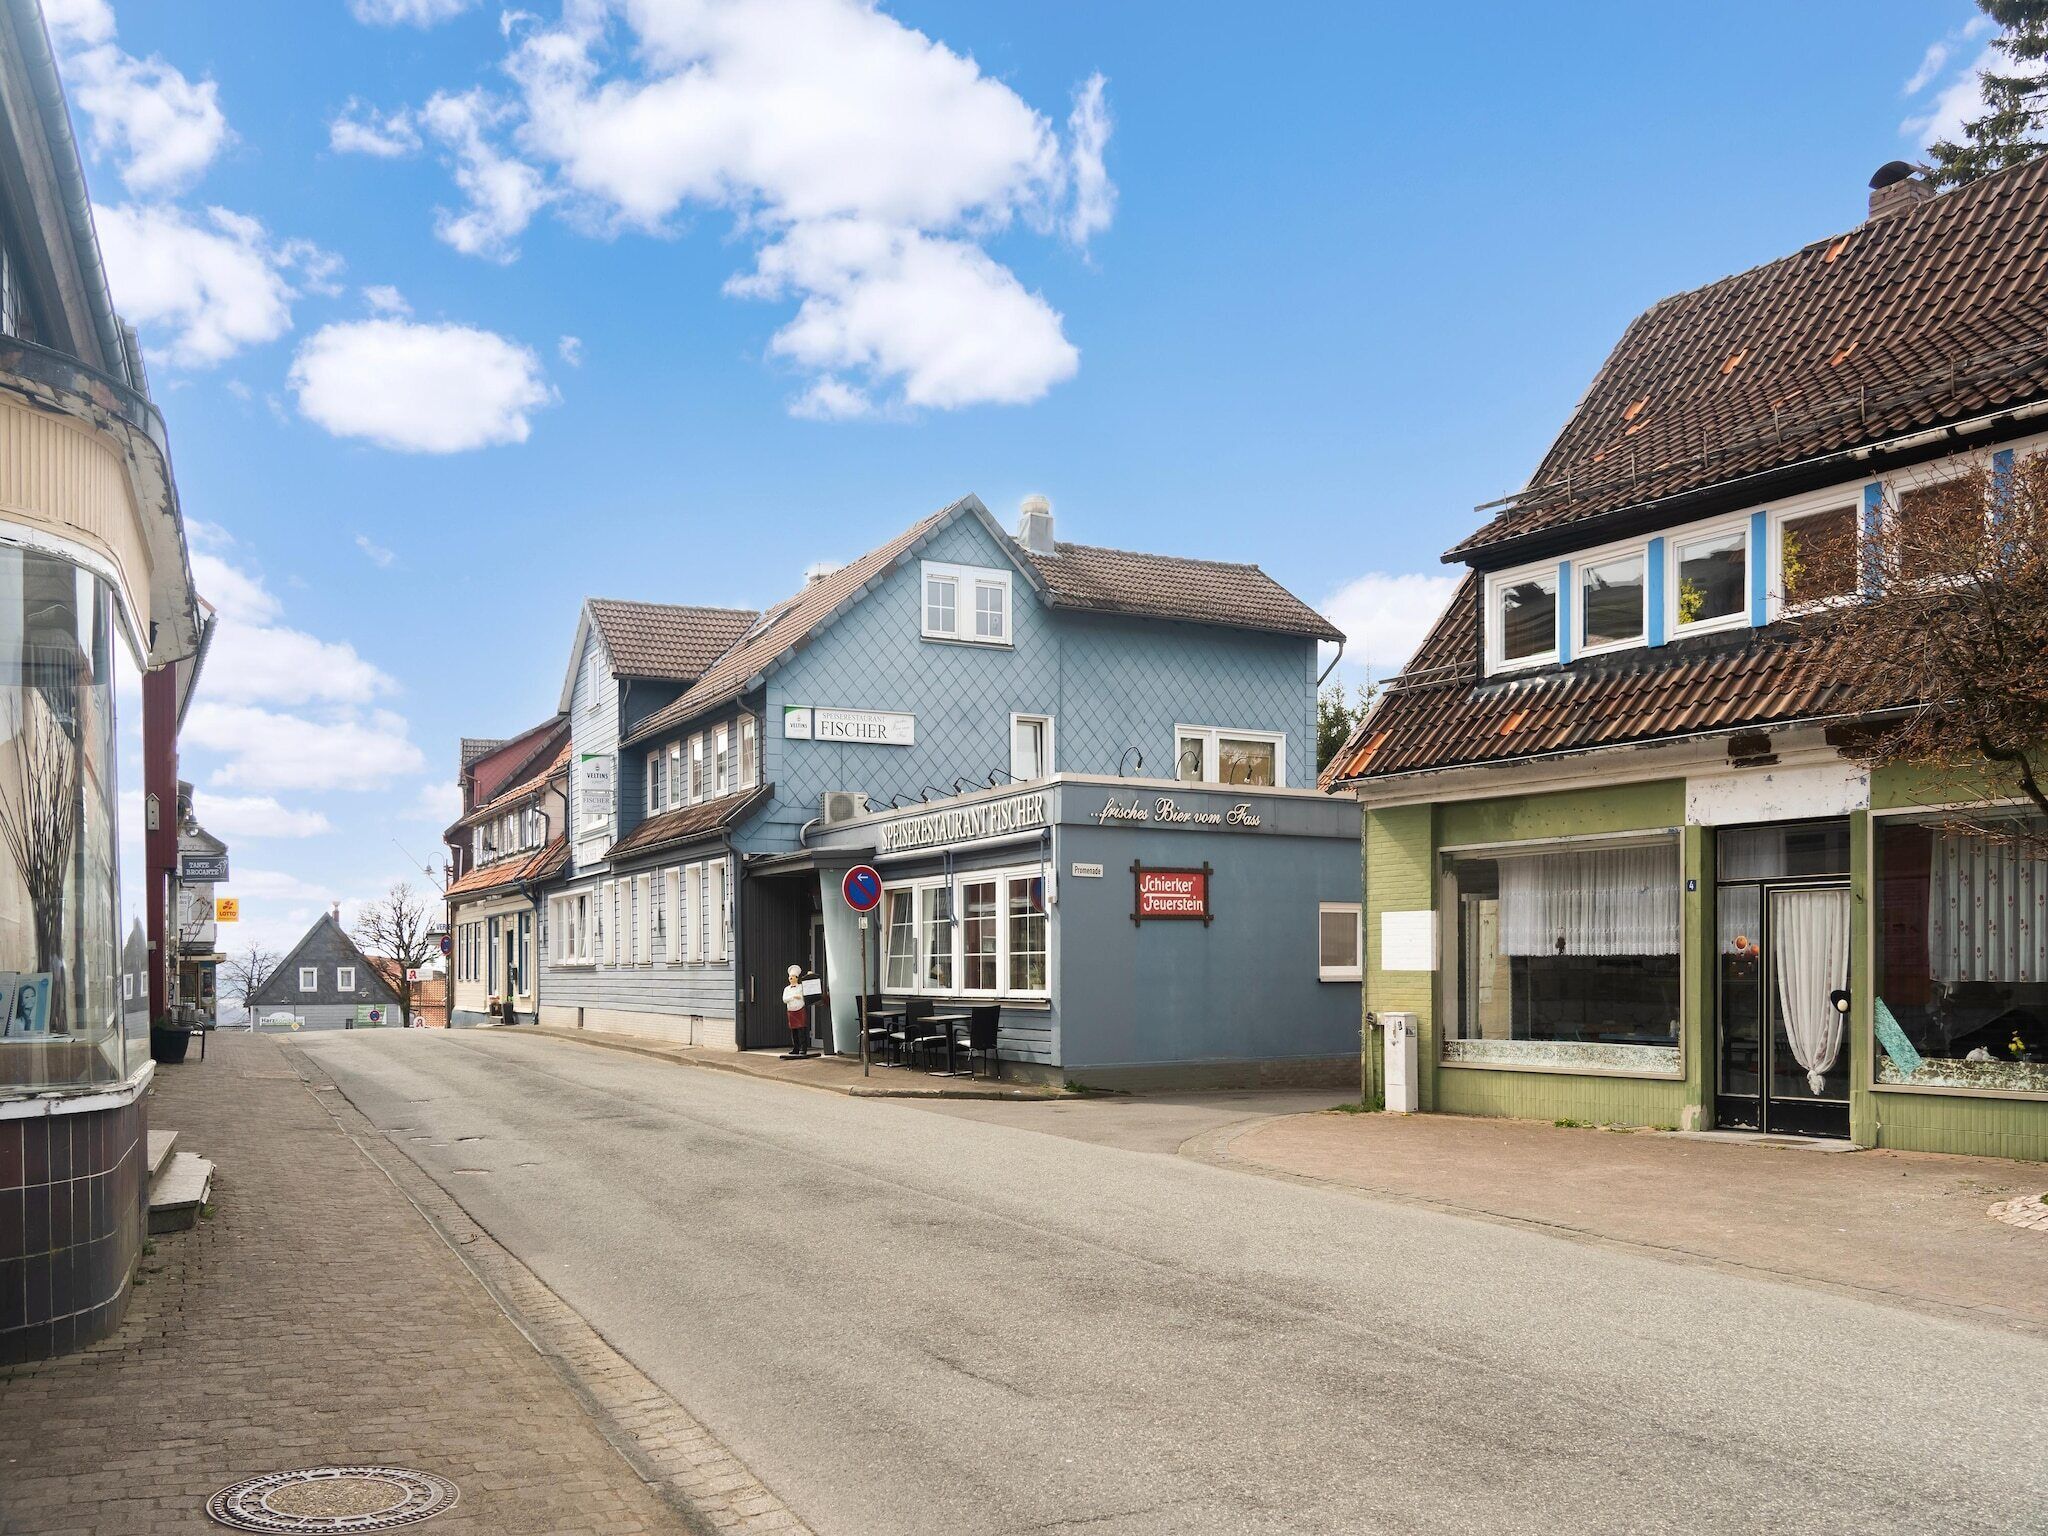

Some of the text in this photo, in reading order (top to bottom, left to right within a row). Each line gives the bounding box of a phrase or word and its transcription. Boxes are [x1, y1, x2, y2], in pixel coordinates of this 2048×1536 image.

[822, 712, 886, 723] SPEISERESTAURANT
[821, 720, 887, 739] FISCHER
[586, 772, 609, 780] VELTINS
[881, 792, 1044, 850] SPEISERESTAURANT FISCHER
[1154, 797, 1192, 822] Bier
[1193, 812, 1221, 825] vom
[1226, 803, 1261, 827] Fass
[1074, 865, 1101, 875] Promenade
[1140, 874, 1193, 893] Schierker
[1688, 880, 1694, 891] 4
[1143, 893, 1204, 912] Feuerstein
